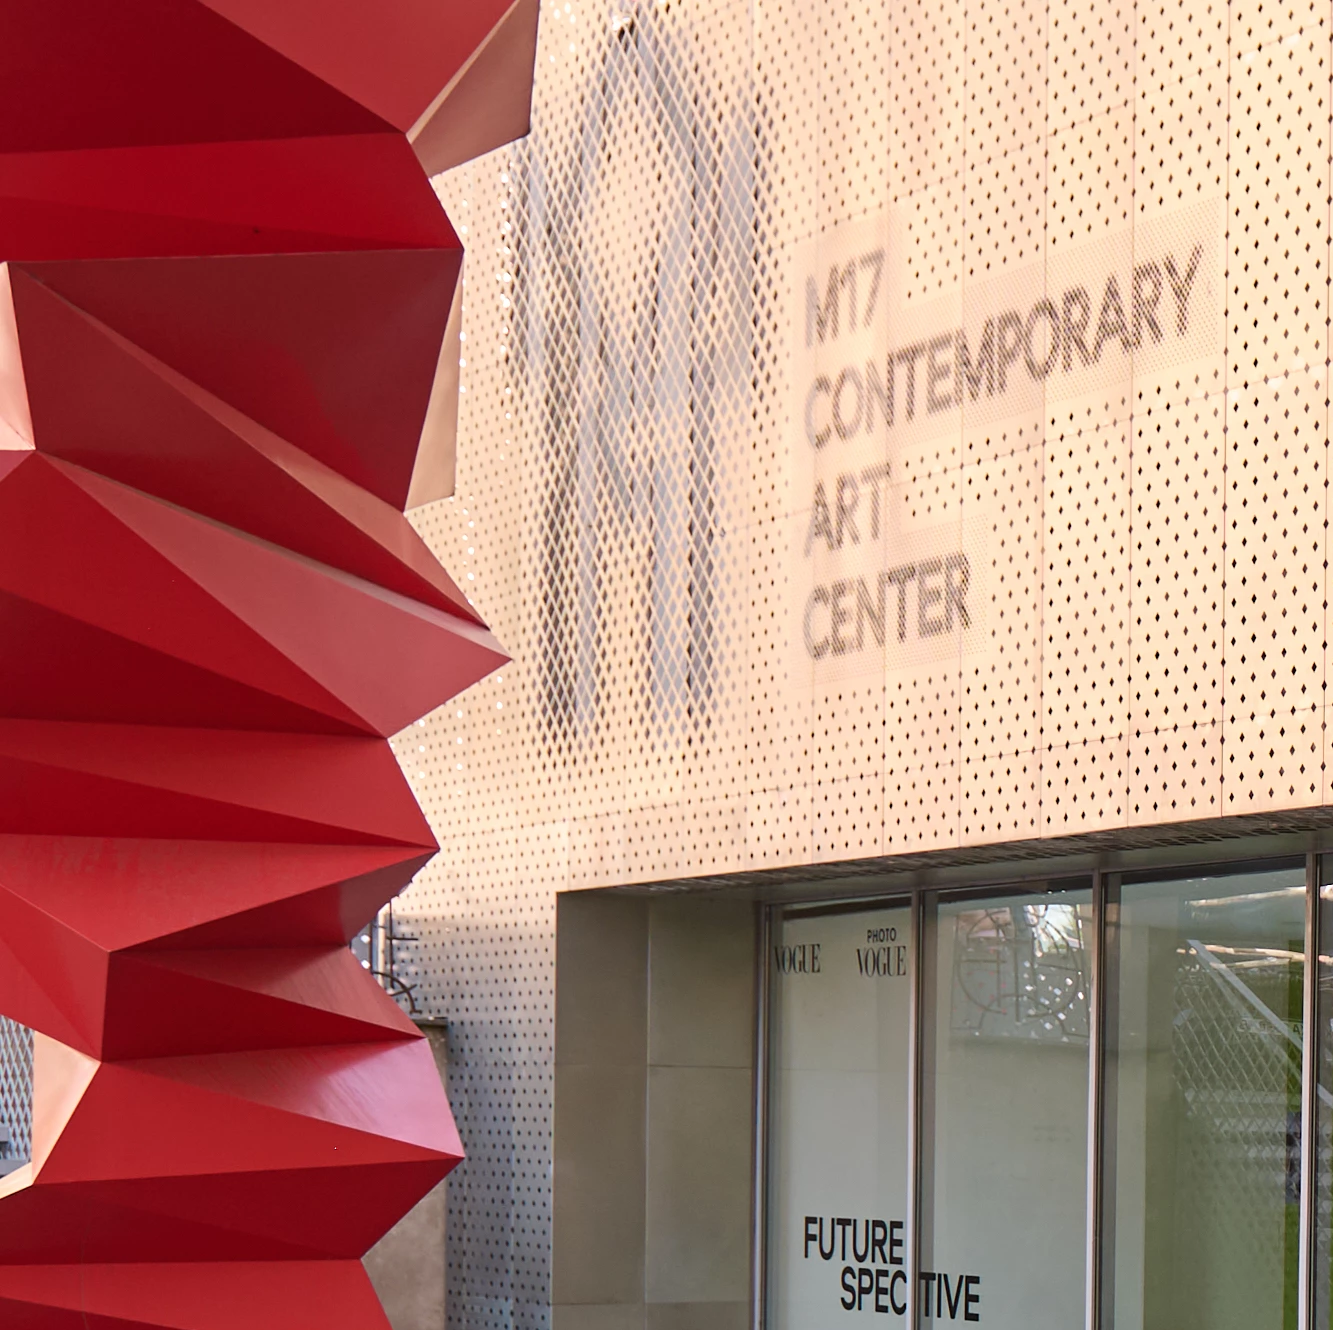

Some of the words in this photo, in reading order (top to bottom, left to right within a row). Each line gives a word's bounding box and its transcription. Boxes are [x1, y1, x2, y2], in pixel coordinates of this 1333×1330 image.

[806, 248, 886, 348] M17
[804, 245, 1203, 450] CONTEMPORARY
[804, 463, 891, 557] ART
[803, 552, 972, 661] CENTER
[775, 943, 821, 974] VOGUE
[856, 945, 907, 977] VOGUE
[867, 927, 897, 942] PHOTO
[804, 1215, 904, 1265] FUTURE
[840, 1266, 981, 1322] SPECTIVE
